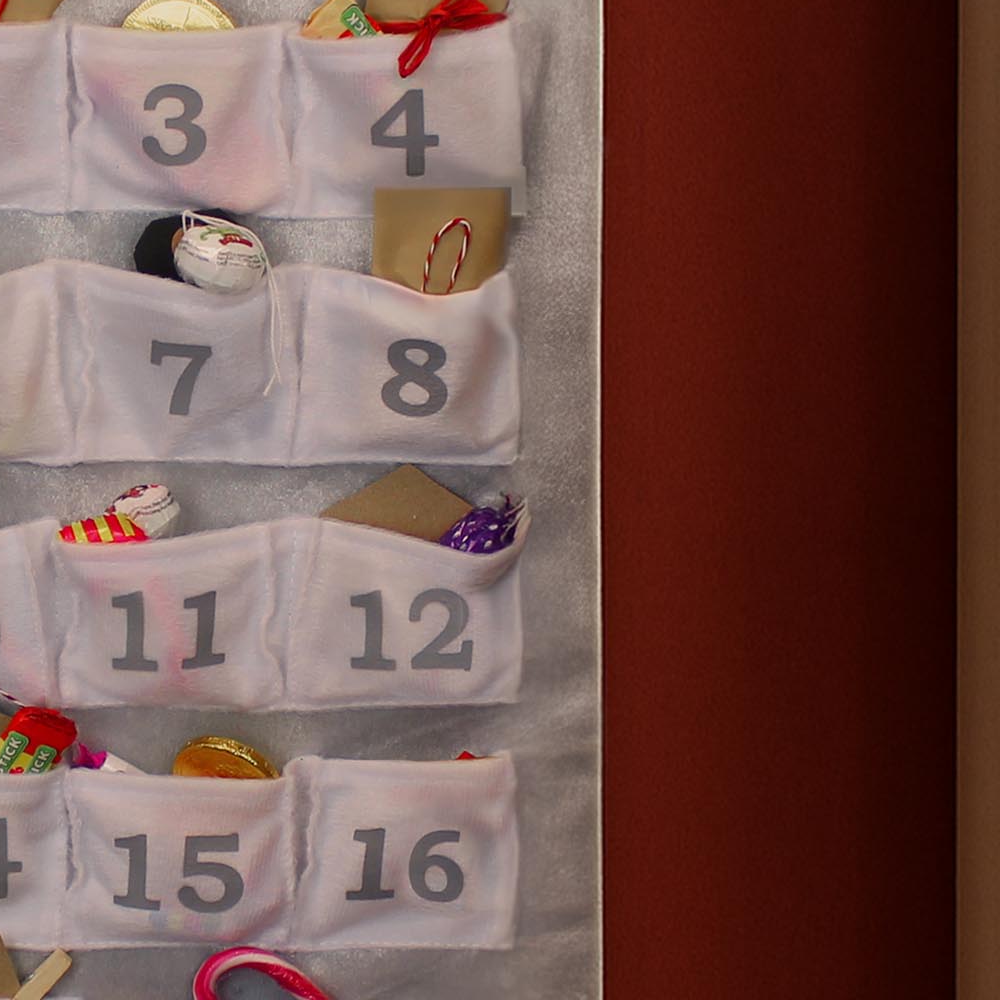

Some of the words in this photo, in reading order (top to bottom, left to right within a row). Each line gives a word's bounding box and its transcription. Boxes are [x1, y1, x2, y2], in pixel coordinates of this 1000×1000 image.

[347, 12, 369, 37] ICK
[141, 83, 207, 167] 3
[370, 88, 440, 178] 4
[149, 338, 214, 417] 7
[380, 337, 449, 418] 8
[110, 590, 226, 673] 11
[349, 587, 474, 672] 12
[31, 750, 50, 774] ICK
[112, 832, 245, 915] 15
[345, 827, 466, 904] 16
